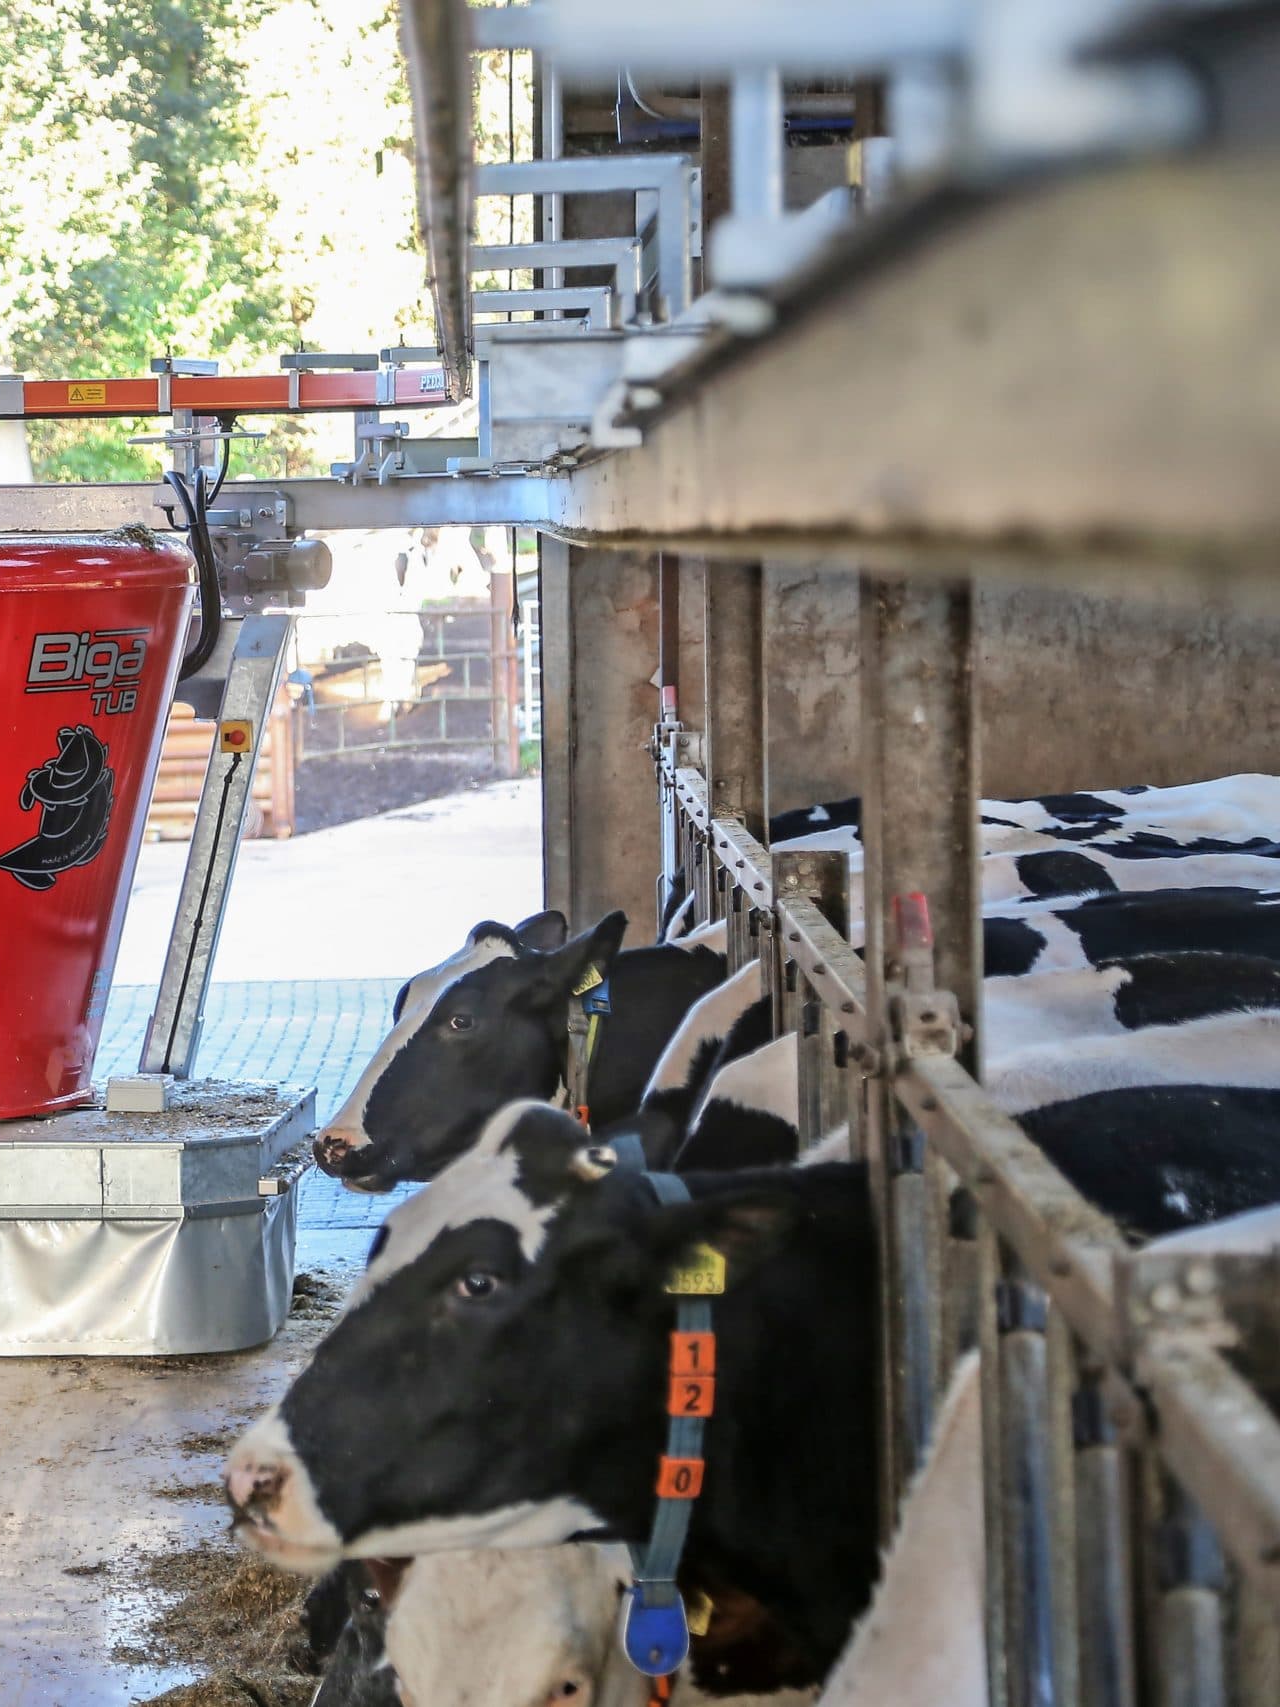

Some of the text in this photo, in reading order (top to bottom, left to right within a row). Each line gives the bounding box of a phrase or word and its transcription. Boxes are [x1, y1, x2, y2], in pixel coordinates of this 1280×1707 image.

[27, 631, 147, 689] Biga
[91, 690, 138, 716] TUB
[687, 1341, 700, 1369] 1
[685, 1384, 702, 1411] 2
[674, 1467, 692, 1493] 0
